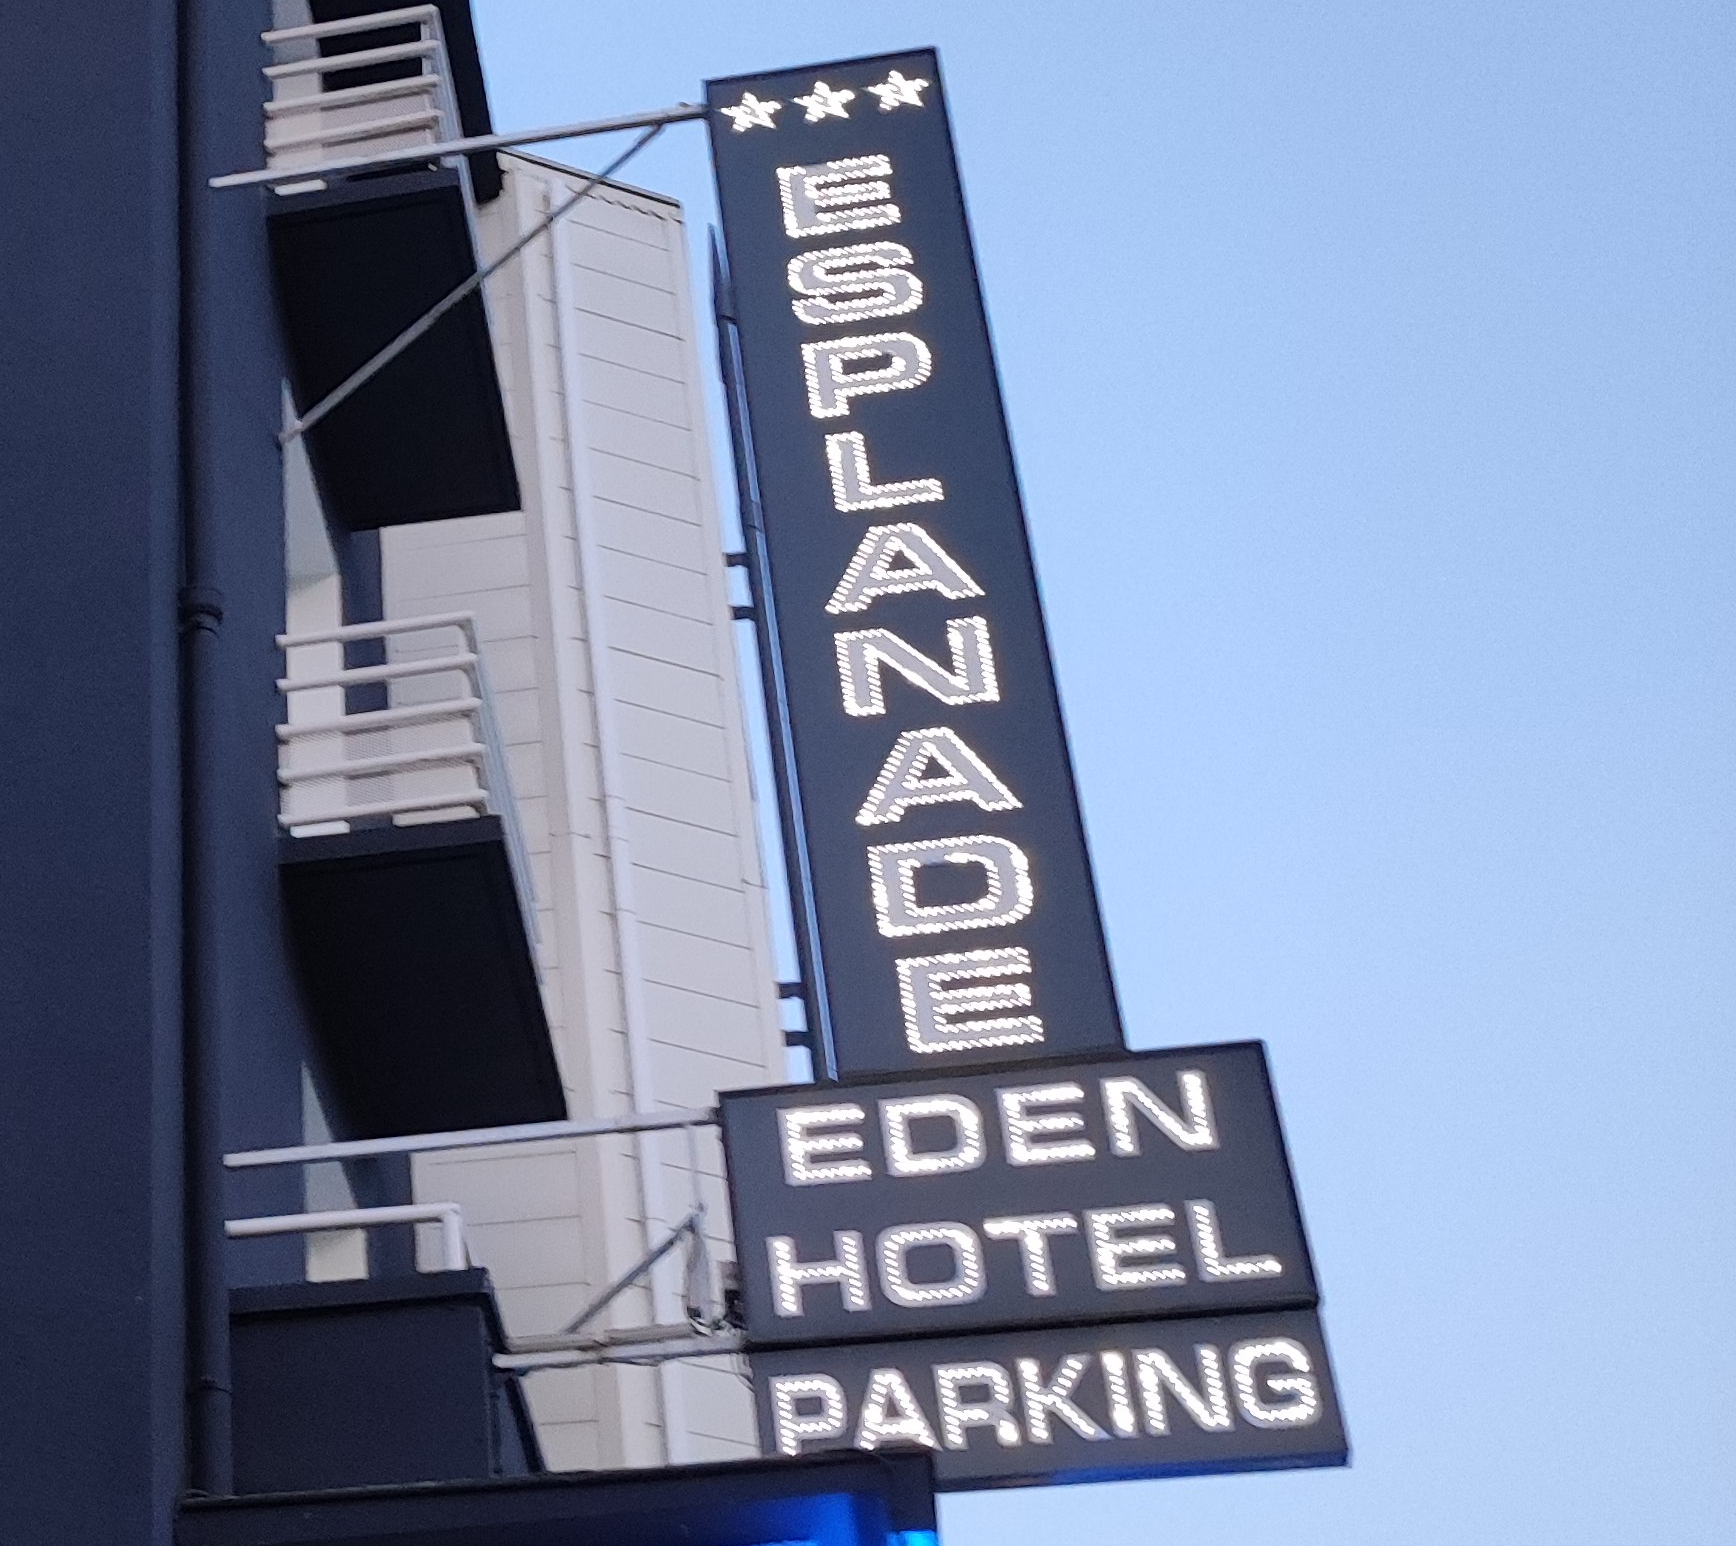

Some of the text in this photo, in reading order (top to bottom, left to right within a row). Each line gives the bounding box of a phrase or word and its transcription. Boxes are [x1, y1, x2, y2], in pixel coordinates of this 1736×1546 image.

[775, 153, 1045, 1054] ESPLANADE
[775, 1069, 1221, 1188] EDEN
[765, 1198, 1284, 1318] HOTEL
[767, 1336, 1322, 1457] PARKING
